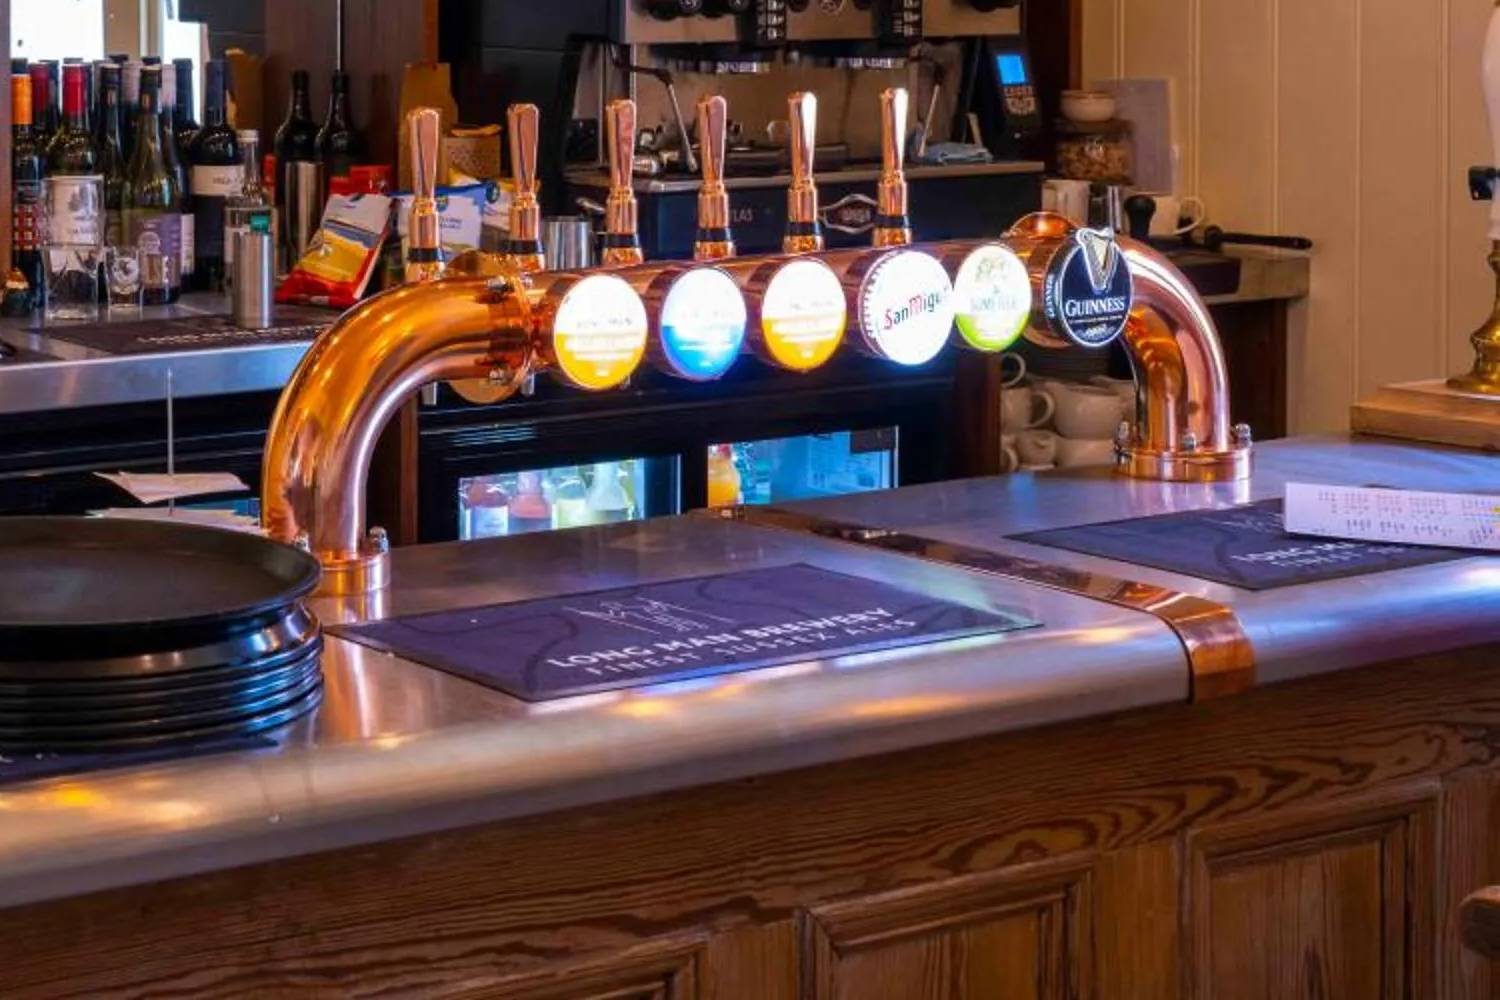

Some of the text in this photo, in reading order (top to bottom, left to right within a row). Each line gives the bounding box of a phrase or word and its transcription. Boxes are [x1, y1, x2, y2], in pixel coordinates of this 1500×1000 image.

[1065, 296, 1127, 317] GUINNESS
[547, 646, 652, 668] LONG
[654, 632, 743, 653] MAN
